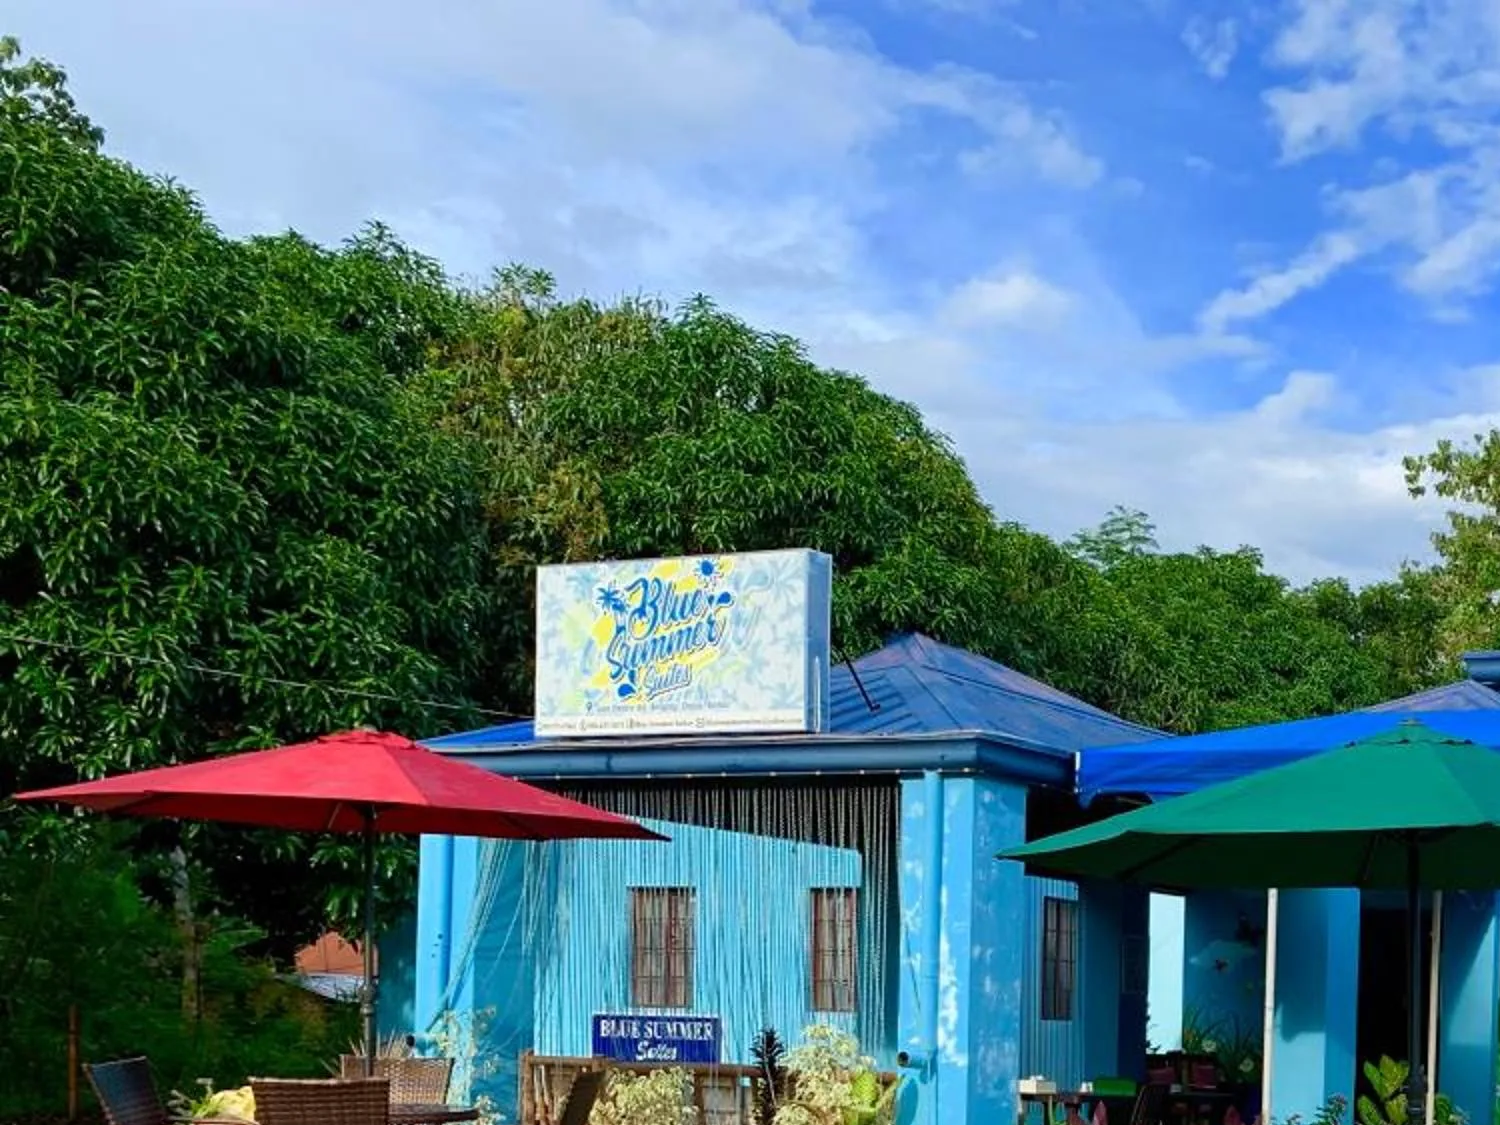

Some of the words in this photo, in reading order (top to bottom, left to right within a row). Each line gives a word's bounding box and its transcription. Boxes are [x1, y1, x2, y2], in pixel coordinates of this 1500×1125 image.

[624, 576, 709, 641] Blue
[606, 613, 722, 681] Summer
[600, 1019, 640, 1039] BLUE
[643, 1021, 714, 1041] SUMMER
